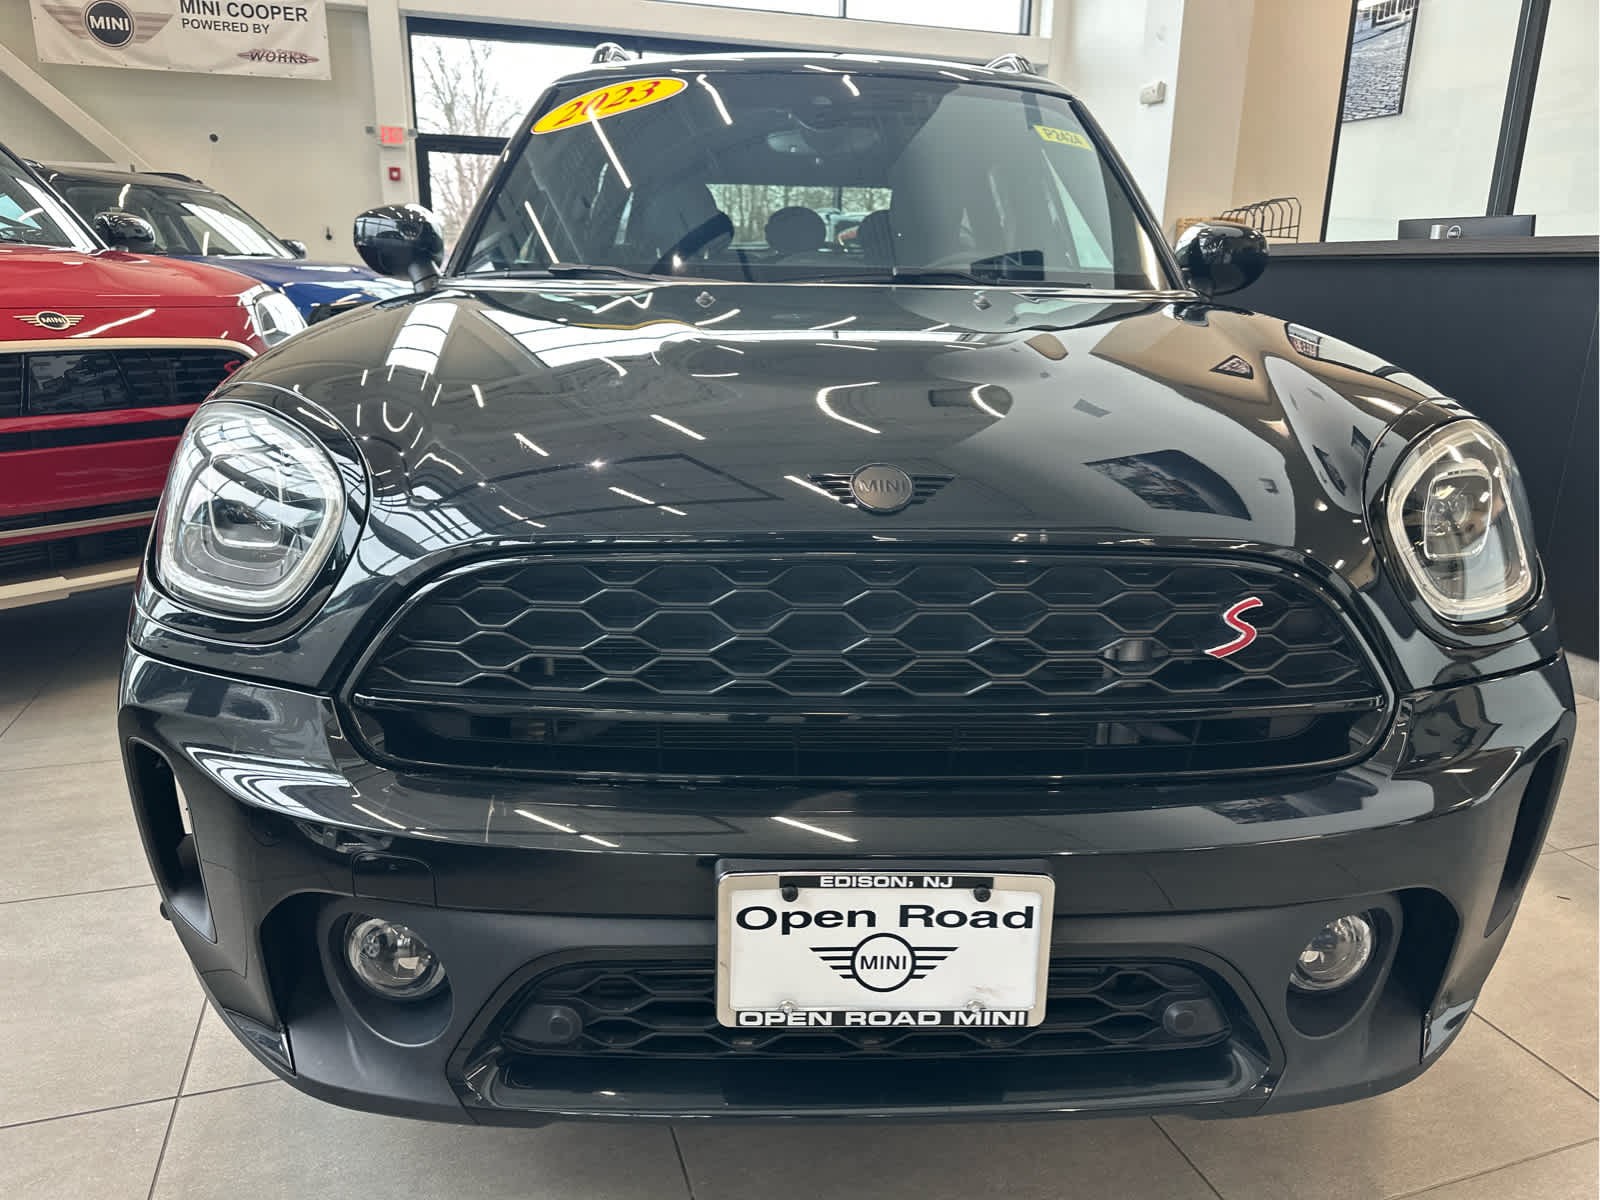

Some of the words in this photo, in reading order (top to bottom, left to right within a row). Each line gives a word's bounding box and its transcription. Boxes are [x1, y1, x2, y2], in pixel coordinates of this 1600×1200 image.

[179, 0, 221, 17] MINI
[226, 2, 309, 22] COOPER
[89, 15, 130, 31] MINI
[181, 18, 249, 33] POWERED
[252, 23, 271, 35] BY
[249, 51, 309, 64] WORKS
[552, 80, 662, 127] 2023
[40, 316, 67, 324] MINI
[858, 479, 906, 493] MINI
[1203, 596, 1264, 659] S
[819, 875, 914, 889] EDISON,
[922, 875, 954, 889] NJ
[735, 905, 877, 935] Open
[898, 904, 1035, 929] Road
[859, 955, 908, 970] MINI
[738, 1011, 833, 1027] OPEN
[844, 1010, 942, 1027] ROAD
[953, 1010, 1026, 1026] MINI
